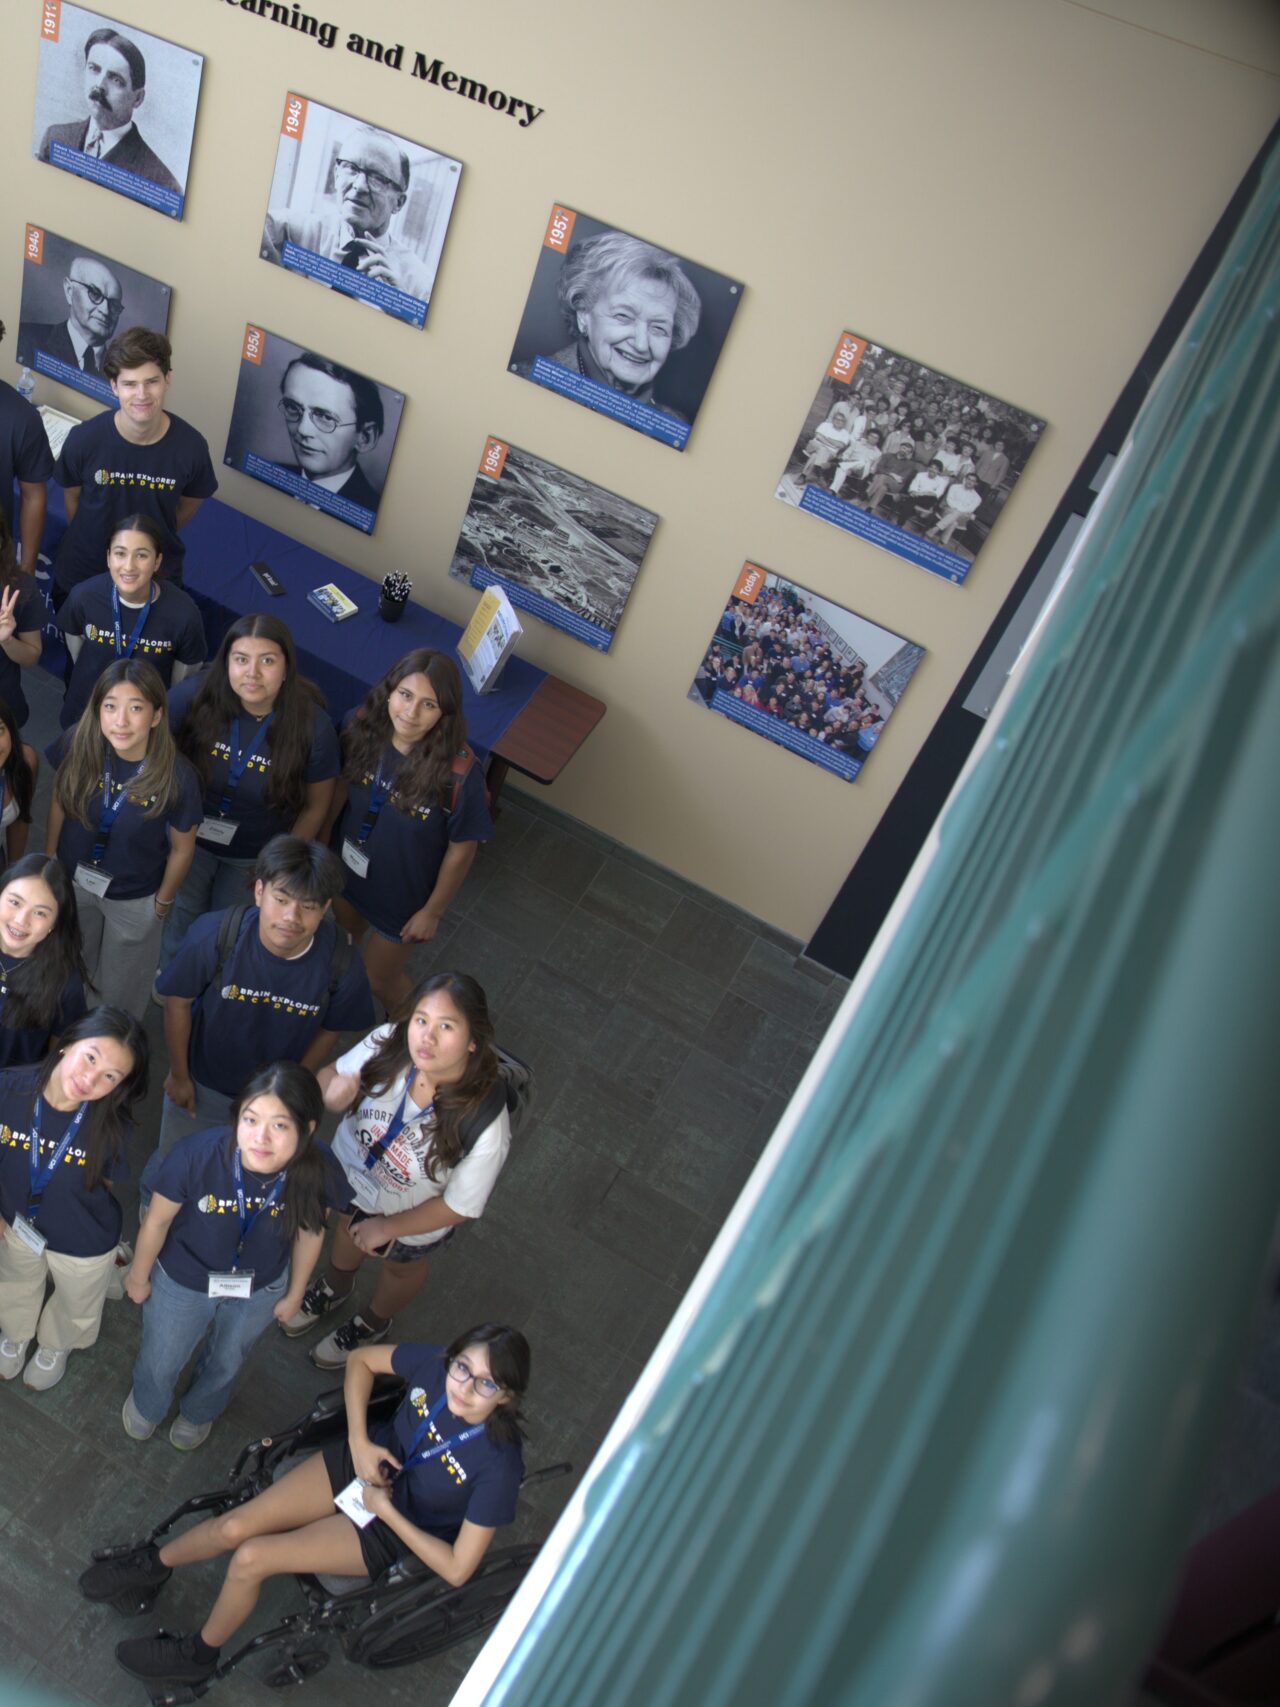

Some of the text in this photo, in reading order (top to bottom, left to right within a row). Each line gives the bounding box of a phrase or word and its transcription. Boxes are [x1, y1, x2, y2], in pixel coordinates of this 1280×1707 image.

[215, 0, 544, 127] earning and Memory
[287, 101, 303, 134] 1949
[110, 479, 175, 490] ACADEMY
[137, 474, 176, 485] EXPLORER
[740, 569, 761, 597] Today
[239, 987, 271, 998] BRAIN
[238, 994, 318, 1017] ACADEMY
[390, 1144, 413, 1168] MADE
[459, 1430, 470, 1441] UCI
[421, 1450, 432, 1460] UCI
